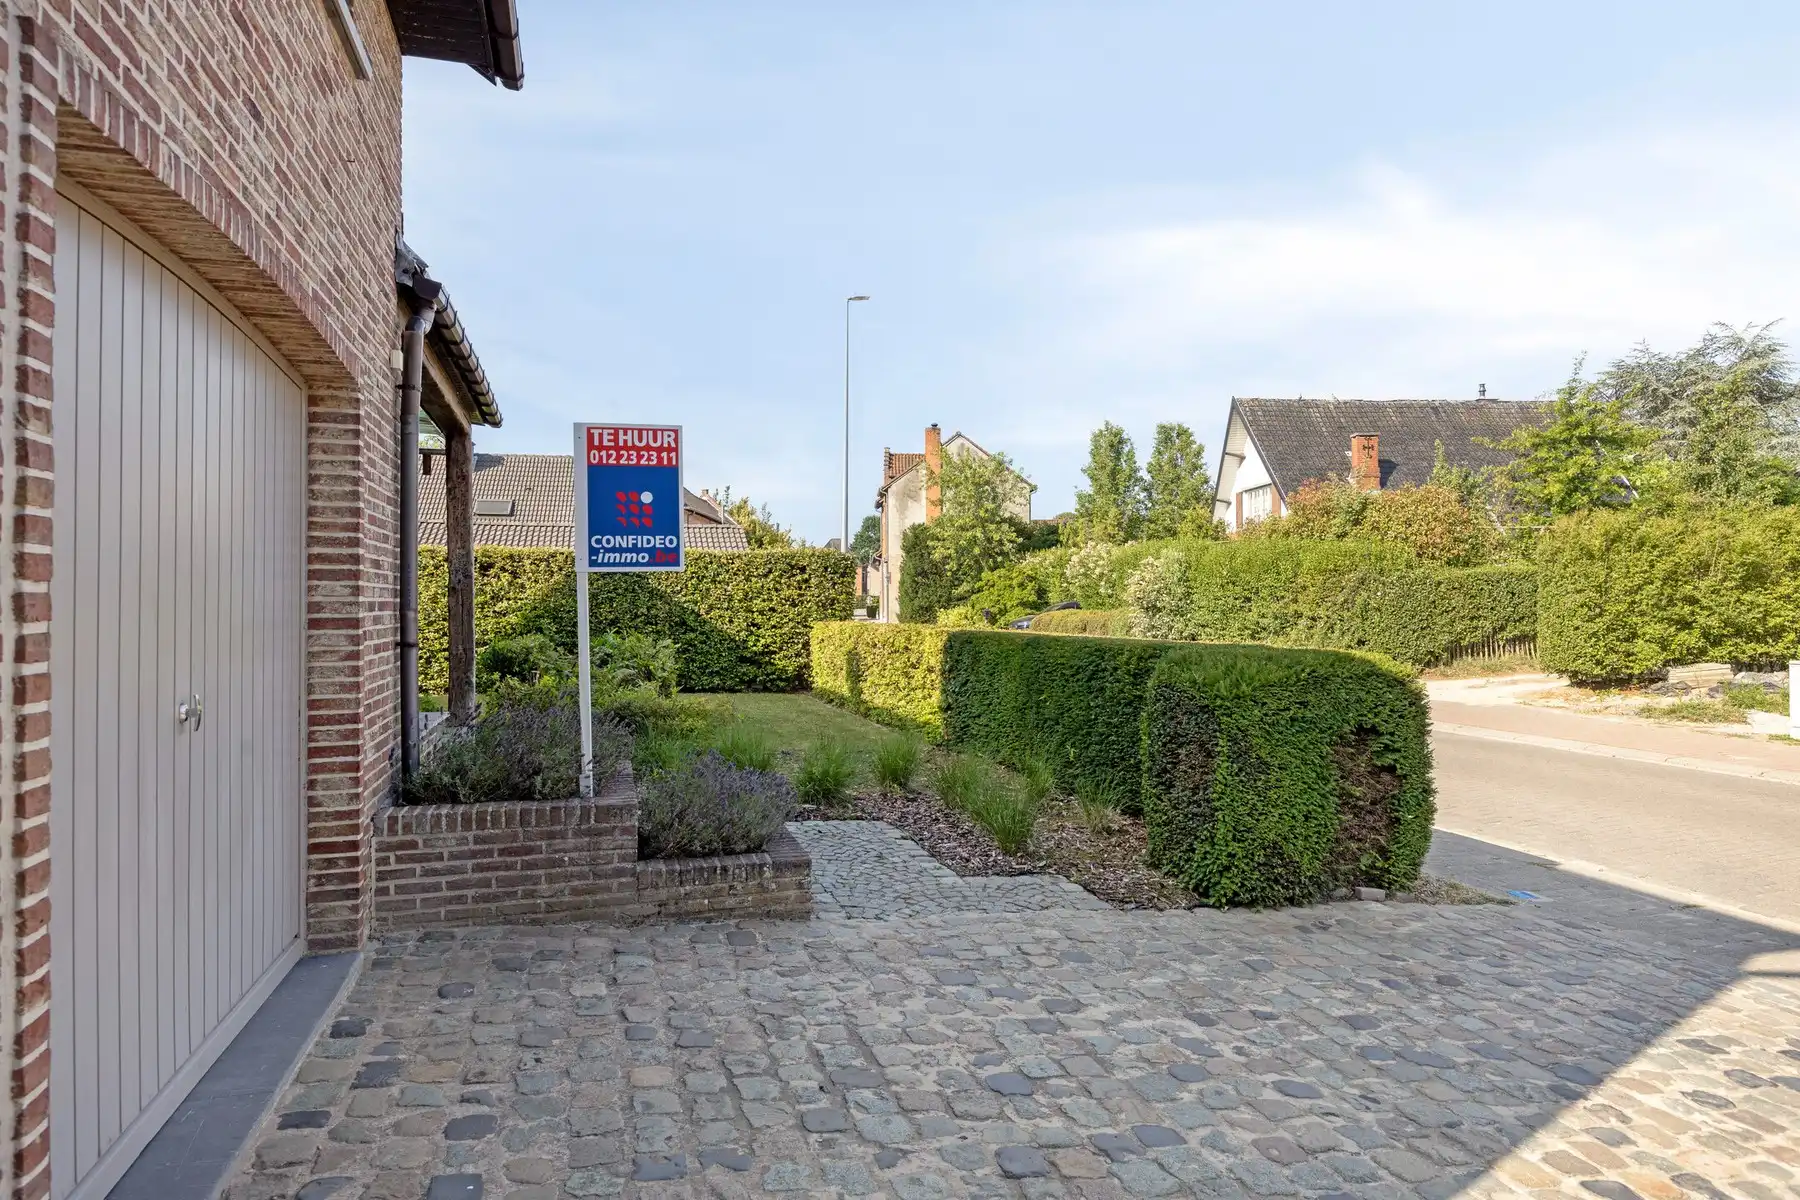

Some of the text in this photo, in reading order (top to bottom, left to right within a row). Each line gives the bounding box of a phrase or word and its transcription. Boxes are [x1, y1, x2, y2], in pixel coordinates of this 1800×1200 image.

[590, 428, 676, 448] TE HUUR
[589, 450, 676, 465] 012 23 23 11
[590, 535, 677, 548] CONFIDEO
